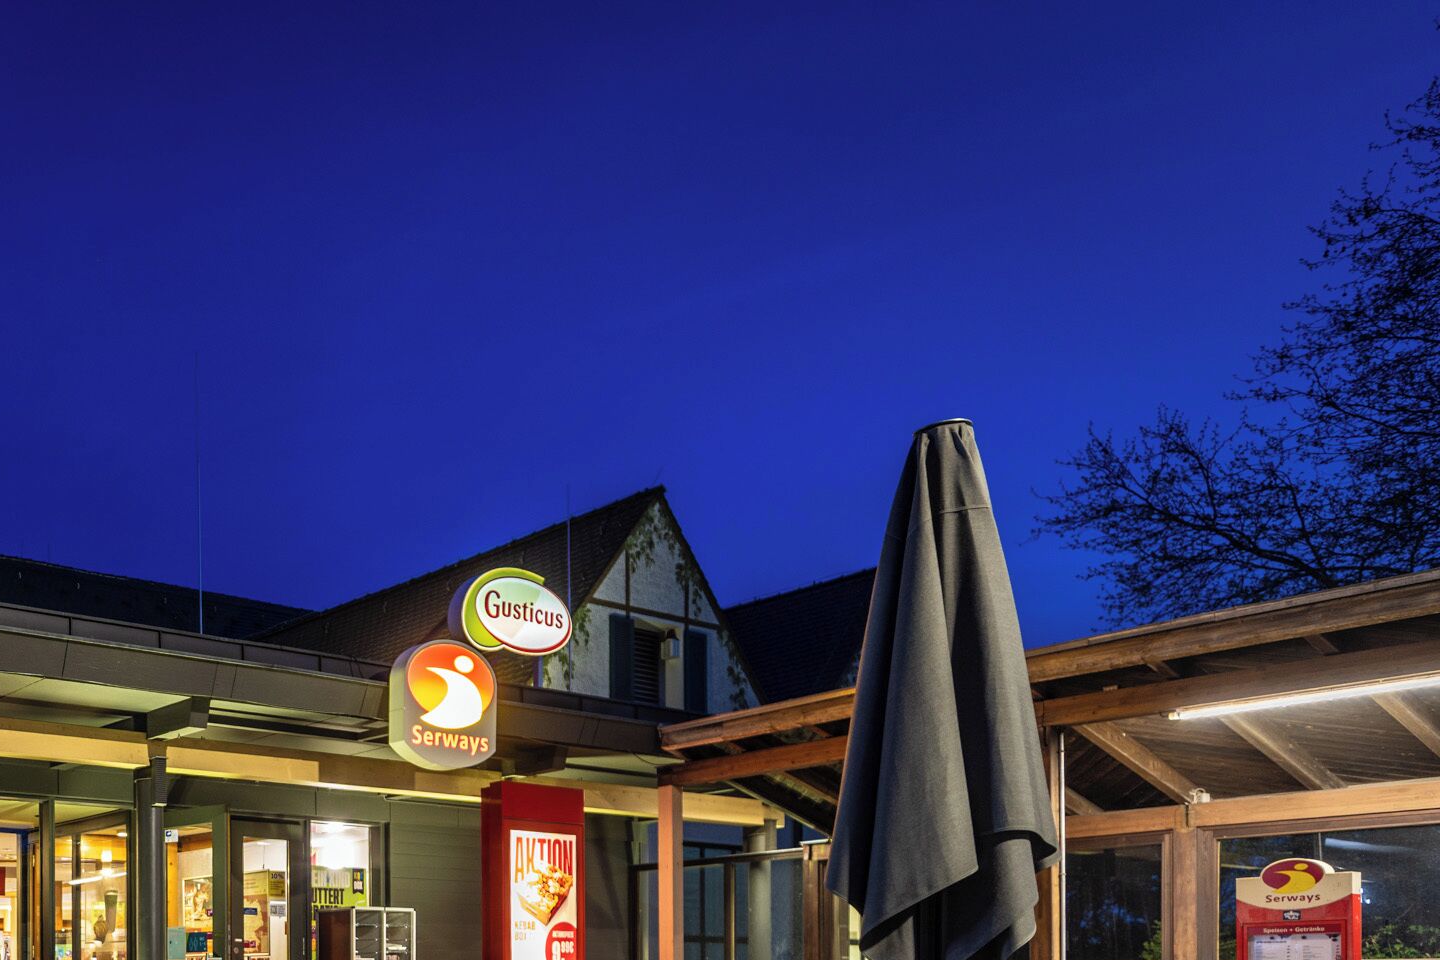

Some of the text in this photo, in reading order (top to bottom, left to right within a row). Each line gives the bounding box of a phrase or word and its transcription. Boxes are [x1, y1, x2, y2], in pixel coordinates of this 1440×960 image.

[484, 590, 564, 629] Gusticus
[411, 724, 489, 756] Serways
[515, 836, 573, 883] AKTION
[1265, 894, 1321, 903] Serways
